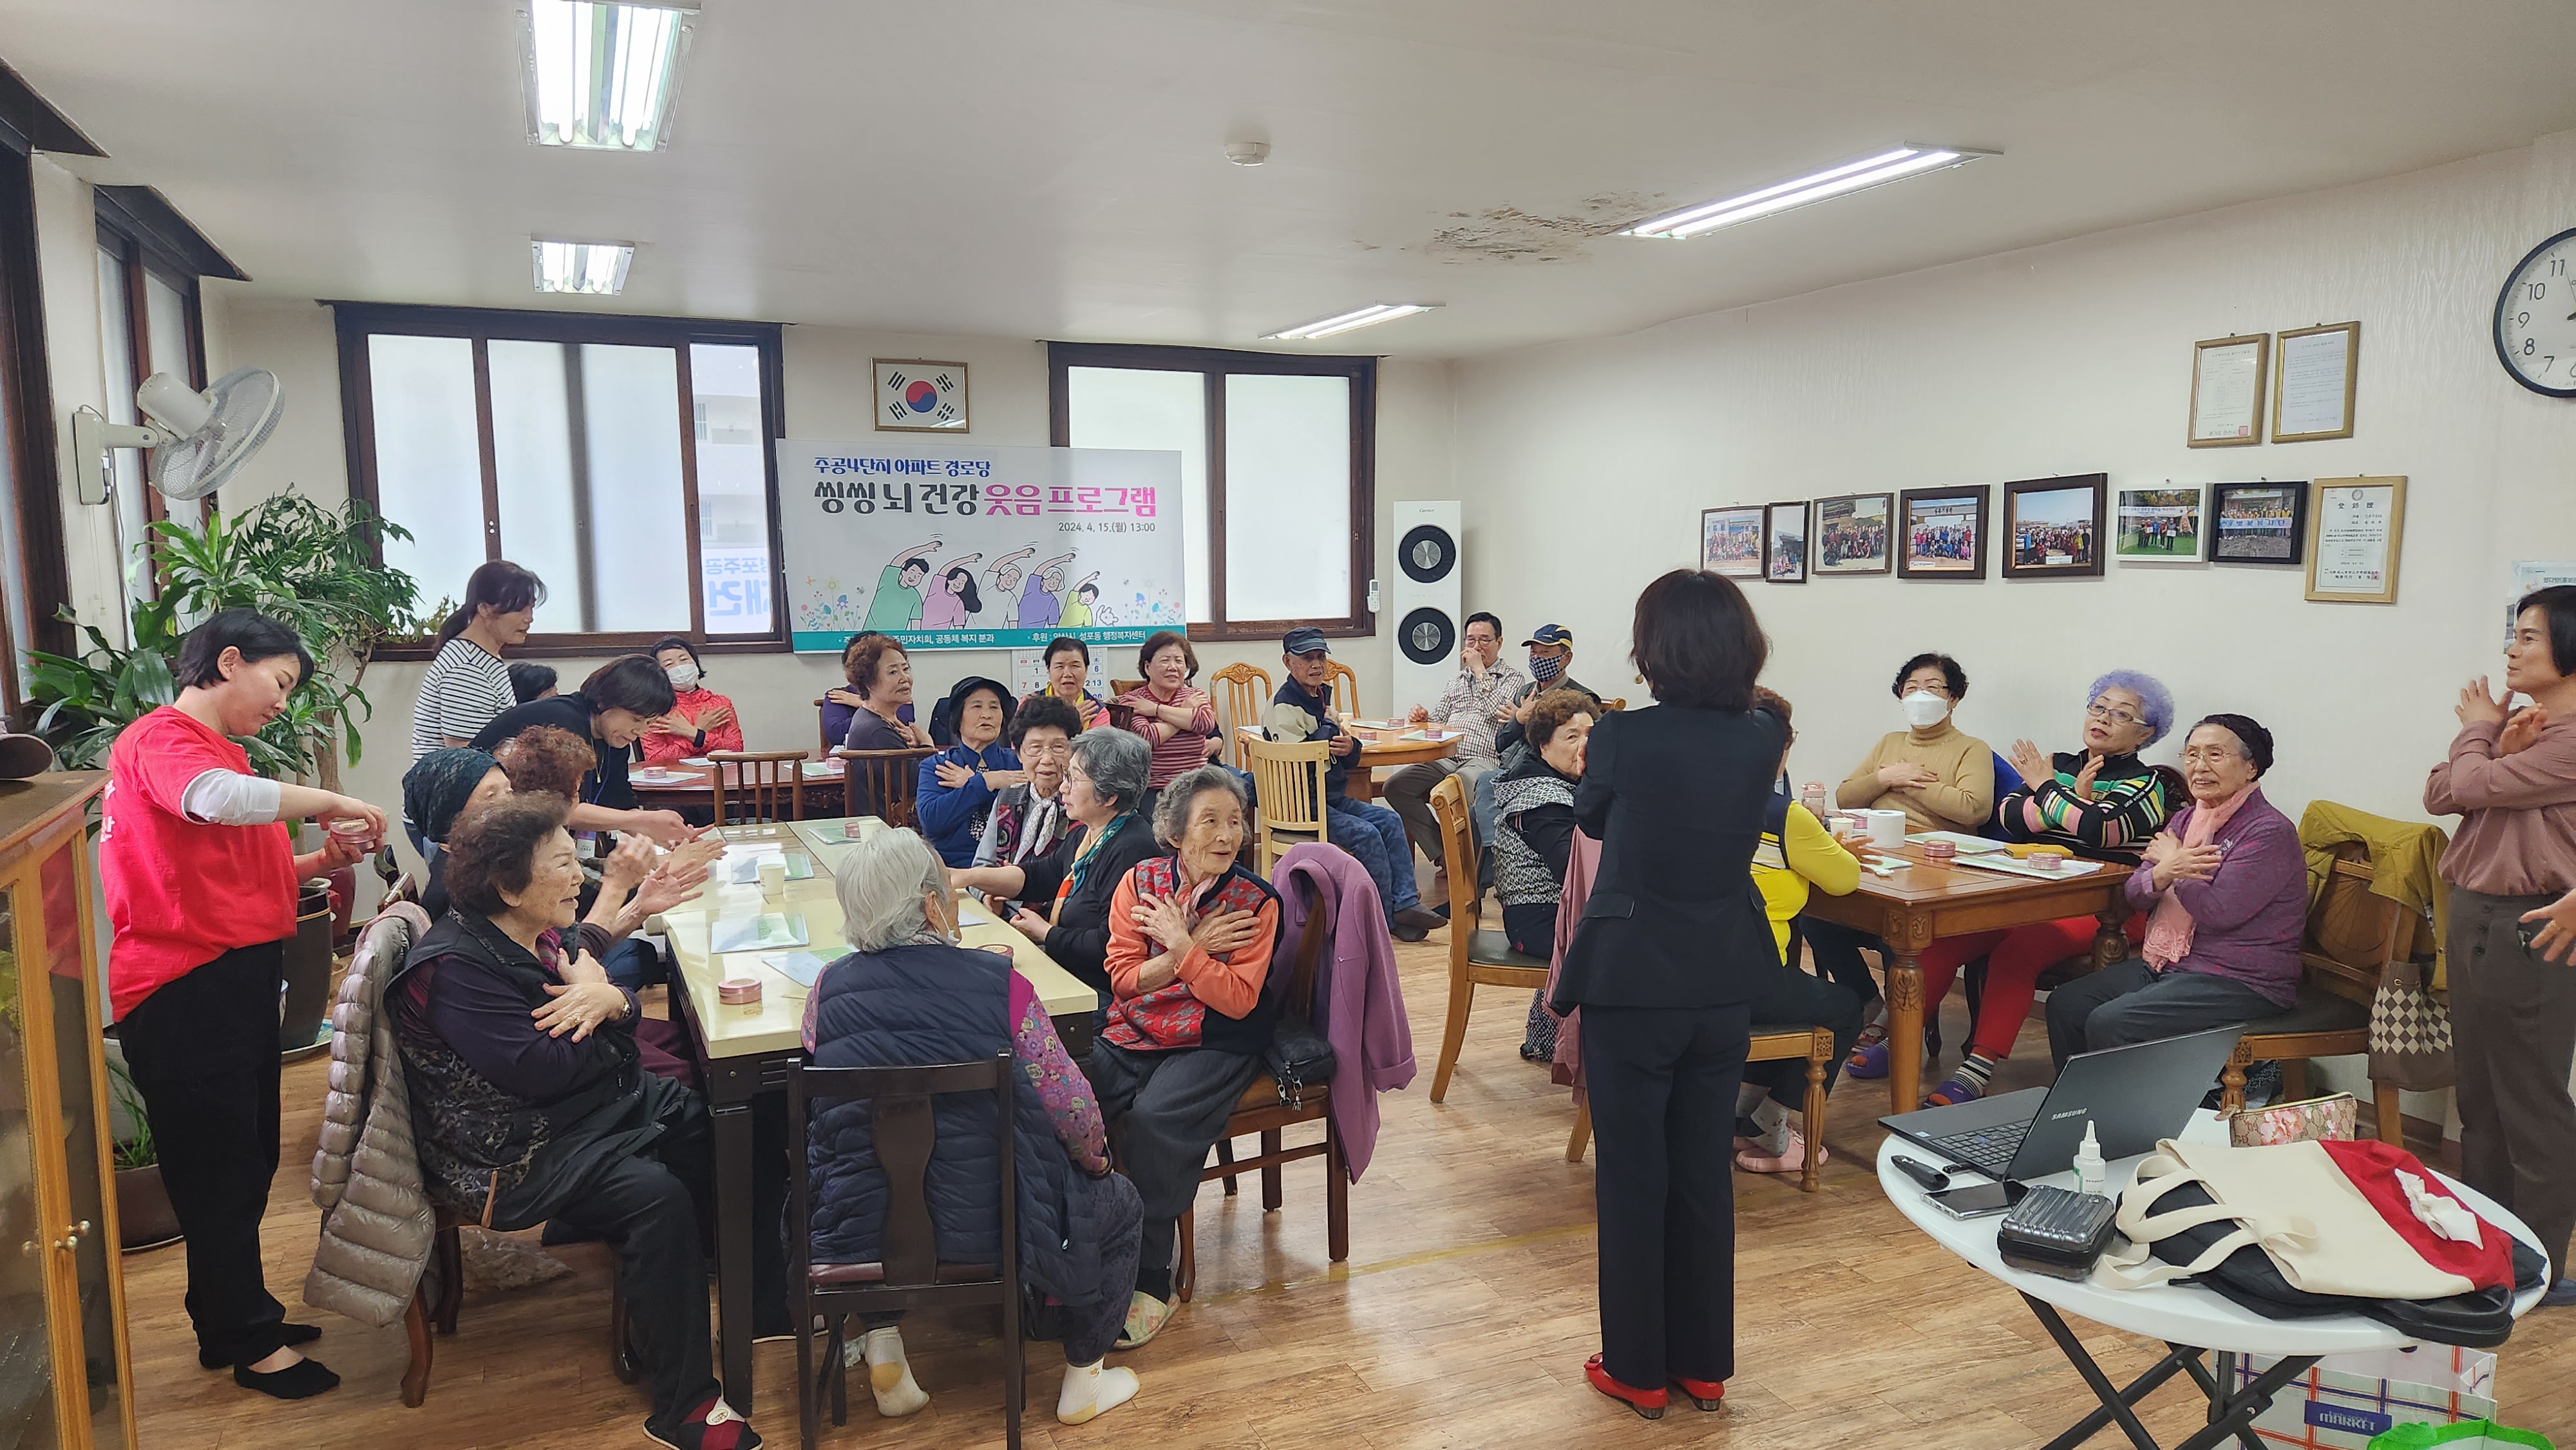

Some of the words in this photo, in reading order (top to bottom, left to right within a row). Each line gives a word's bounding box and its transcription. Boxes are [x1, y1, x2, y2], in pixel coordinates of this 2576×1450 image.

[2550, 259, 2566, 277] 11
[2528, 282, 2546, 301] 10
[2517, 311, 2530, 329] 9
[2523, 337, 2535, 356] 8
[2544, 355, 2555, 372] 7
[814, 457, 891, 475] 주공4단지
[894, 458, 942, 476] 아파트
[944, 460, 991, 478] 경로당
[814, 481, 876, 514] 씽씽
[882, 482, 913, 513] 뇌
[918, 482, 980, 516] 건강
[984, 484, 1042, 516] 웃음
[1047, 486, 1156, 517] 프로그램
[1058, 522, 1084, 532] 2024.
[1086, 522, 1095, 532] 4.
[1131, 523, 1155, 532] 13:00
[935, 634, 960, 644] 공동체
[961, 634, 977, 643] 복지
[978, 634, 995, 643] 분과
[1032, 632, 1048, 642] 후원
[1079, 632, 1101, 641] 성포동
[1103, 630, 1146, 641] 행정복지센터
[2051, 1107, 2087, 1120] SAMSUNG
